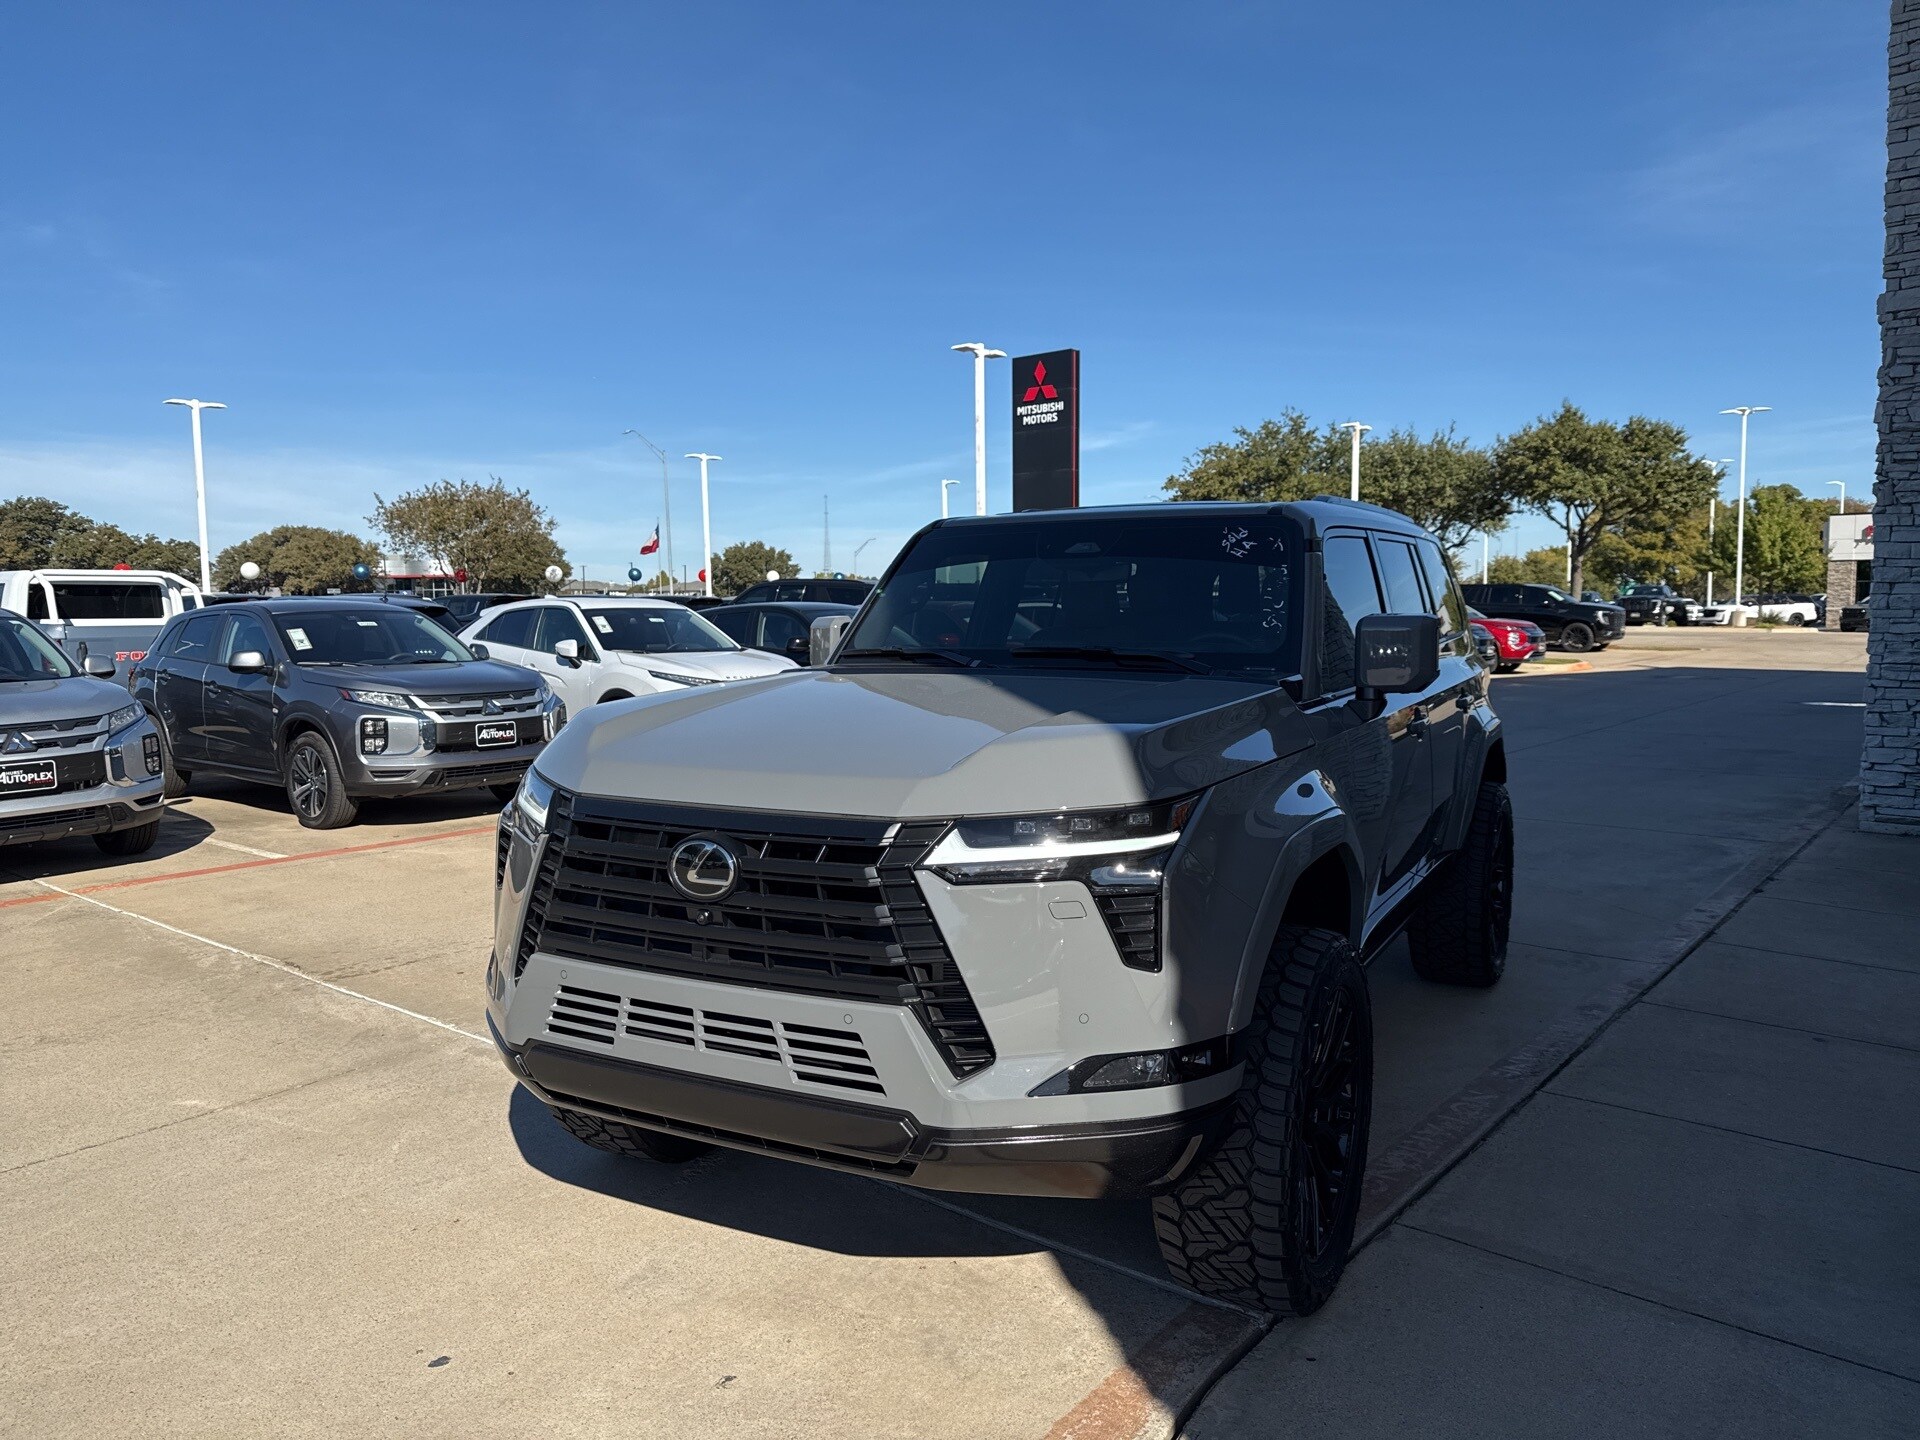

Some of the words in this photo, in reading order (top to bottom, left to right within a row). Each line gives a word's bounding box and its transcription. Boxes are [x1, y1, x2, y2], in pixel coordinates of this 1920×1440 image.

[1017, 401, 1064, 416] MITSUBISHI
[1022, 412, 1058, 425] MOTORS
[115, 651, 147, 662] FO
[479, 729, 514, 739] AUTOPLEX
[0, 771, 53, 784] AUTOPLEX
